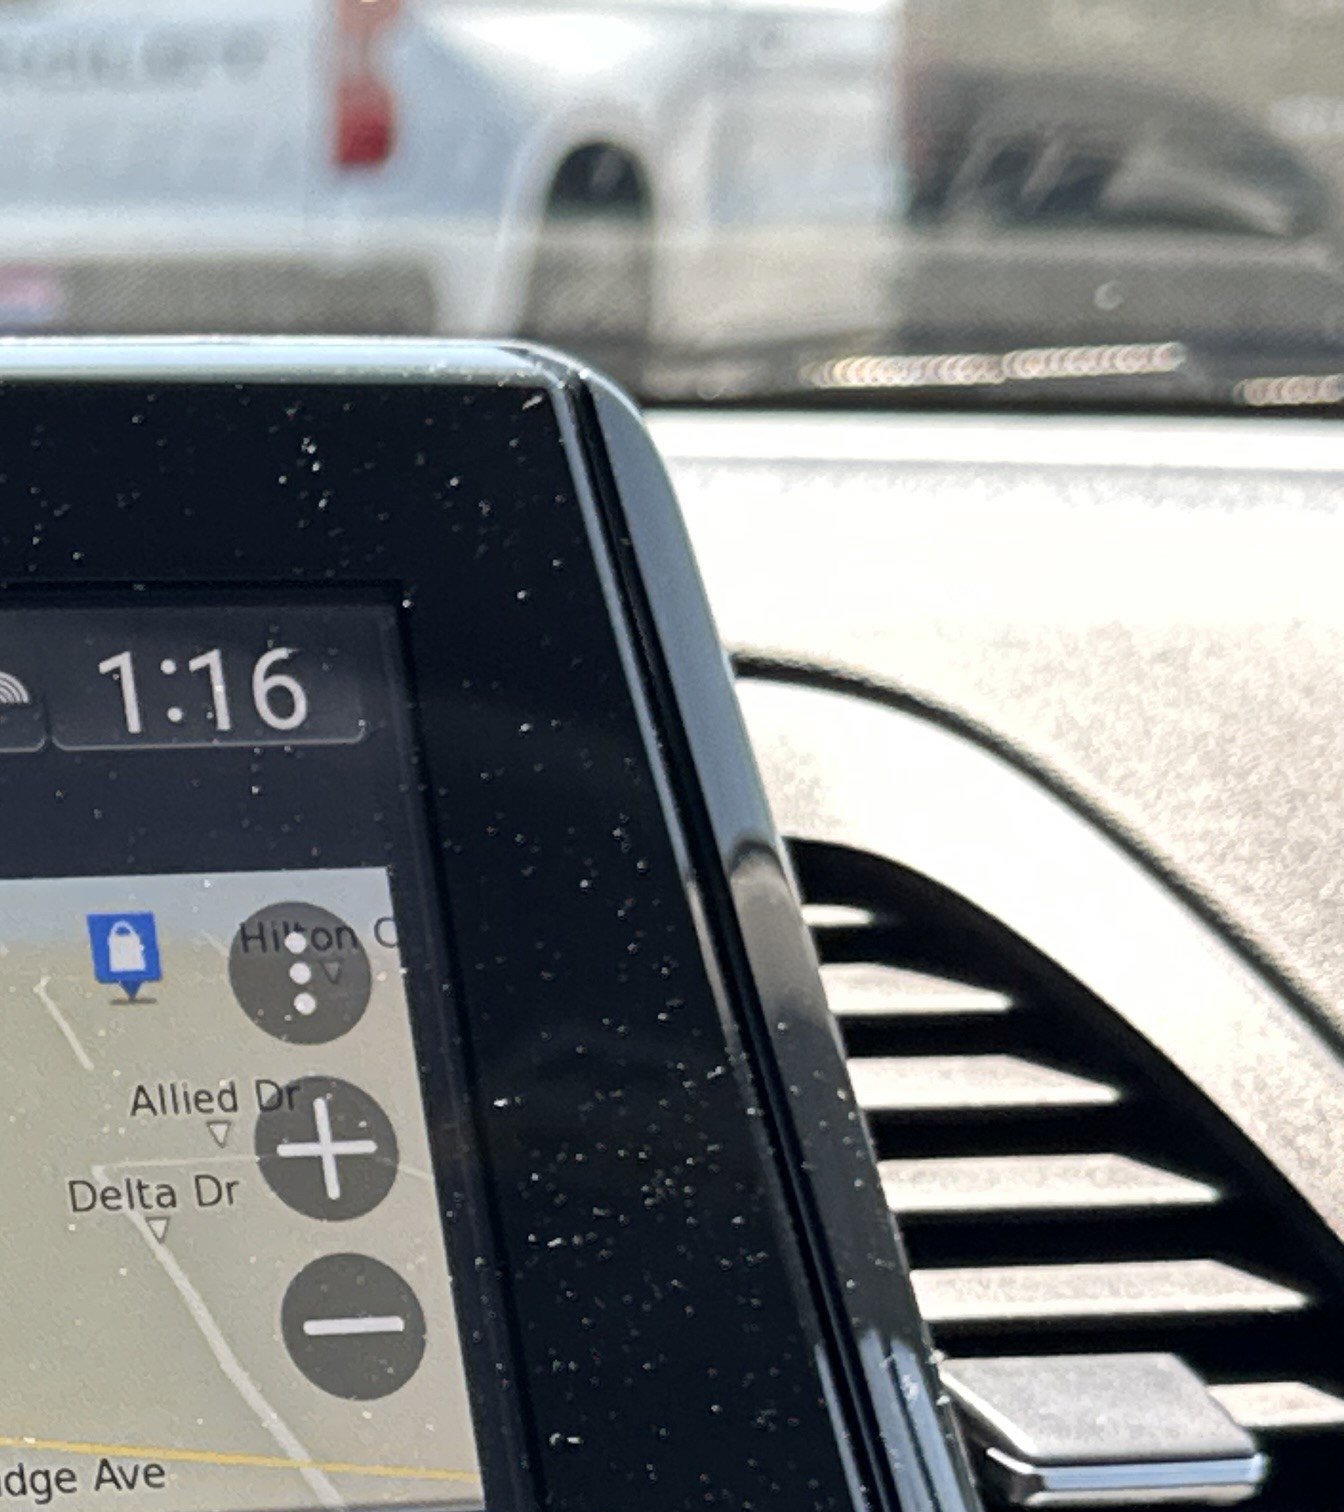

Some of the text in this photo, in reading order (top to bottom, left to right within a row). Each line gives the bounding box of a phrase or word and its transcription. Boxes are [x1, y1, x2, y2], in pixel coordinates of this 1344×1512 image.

[98, 647, 308, 734] 1:16
[129, 1078, 301, 1118] Allied Dr
[67, 1174, 240, 1212] Delta Dr
[93, 1459, 166, 1494] Ave
